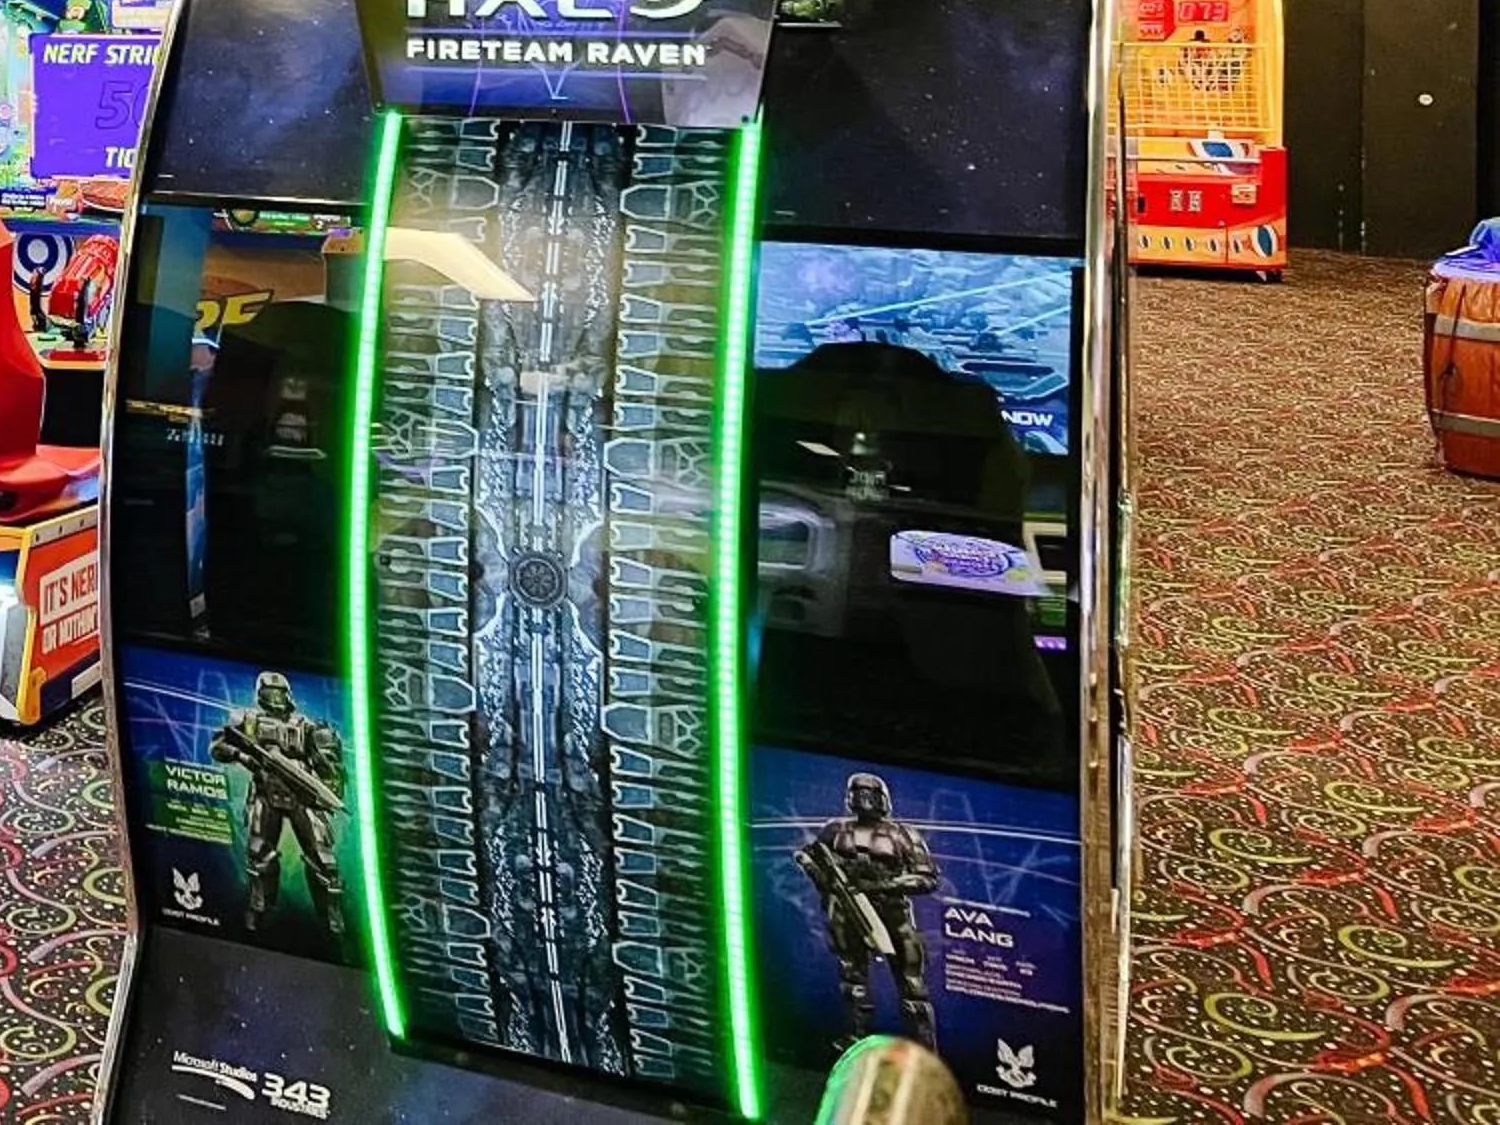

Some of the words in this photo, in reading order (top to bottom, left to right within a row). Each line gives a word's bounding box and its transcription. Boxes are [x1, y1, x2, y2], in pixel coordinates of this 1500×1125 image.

[43, 44, 101, 64] NERF
[406, 39, 573, 63] FIRETEAM
[587, 42, 706, 66] RAVEN
[1001, 410, 1053, 426] NOW
[44, 577, 68, 615] IT'S
[42, 623, 57, 654] OR
[165, 765, 225, 785] VICTOR
[167, 779, 229, 800] RAMOS
[945, 907, 993, 928] AVA
[945, 922, 1015, 948] LANG
[173, 1051, 219, 1072] Microsoft
[261, 1073, 331, 1108] 343
